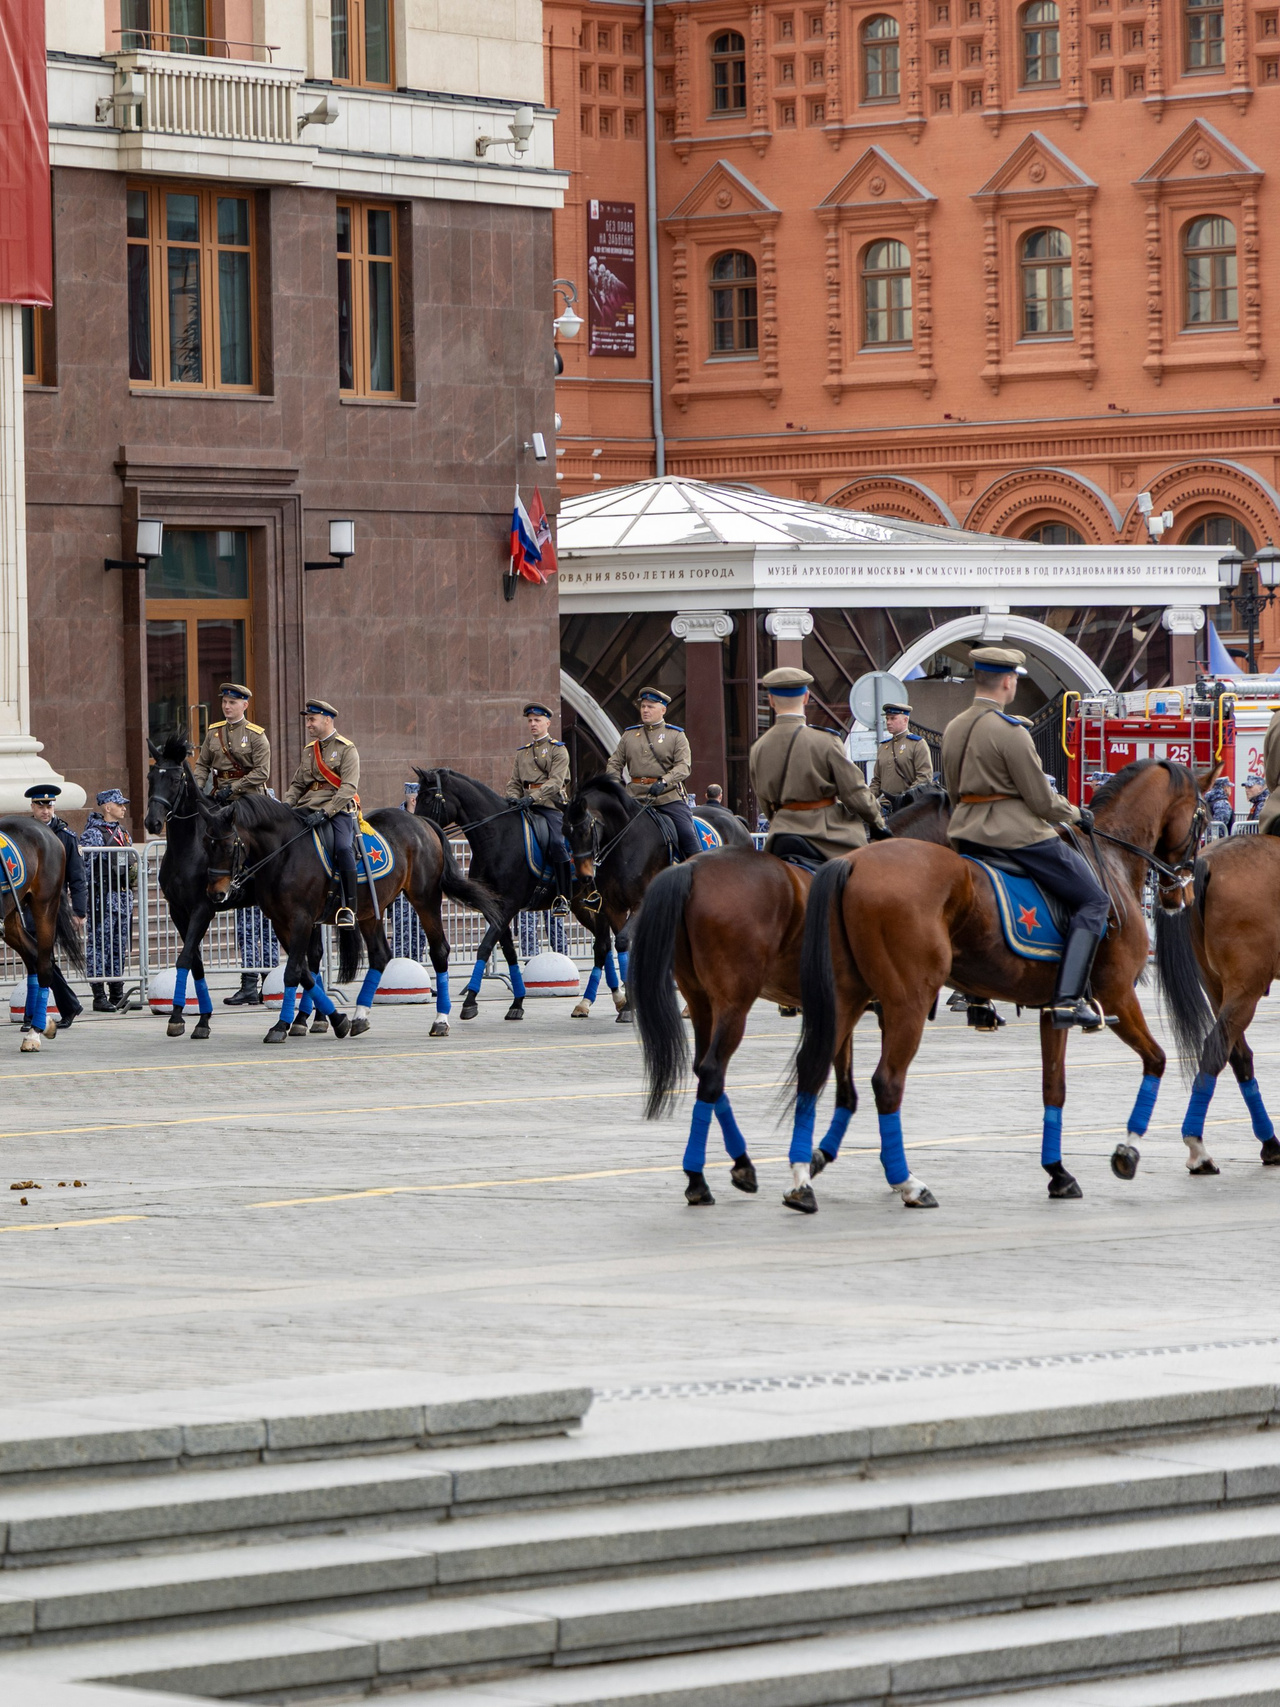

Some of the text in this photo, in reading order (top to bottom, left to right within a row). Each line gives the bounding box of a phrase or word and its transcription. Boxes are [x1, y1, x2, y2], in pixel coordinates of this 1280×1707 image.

[605, 220, 634, 233] БЕЗ ПРАВА
[599, 233, 607, 244] НА
[689, 568, 736, 579] ГОРОДА
[767, 564, 798, 576] МУЗЕЙ
[802, 566, 864, 576] АРХЕОЛОГИИ
[867, 566, 906, 576] МОСКВЫ
[976, 566, 1022, 576] ПОСТРОЕН
[1025, 566, 1030, 576] В
[1033, 566, 1050, 577] ГОД
[1052, 566, 1125, 577] ПРАЗДНОВАНИЯ
[1145, 566, 1174, 576] ЛЕТИЯ
[1176, 566, 1207, 577] ГОРОДА
[1110, 743, 1129, 755] АЦ
[1170, 746, 1190, 762] 25
